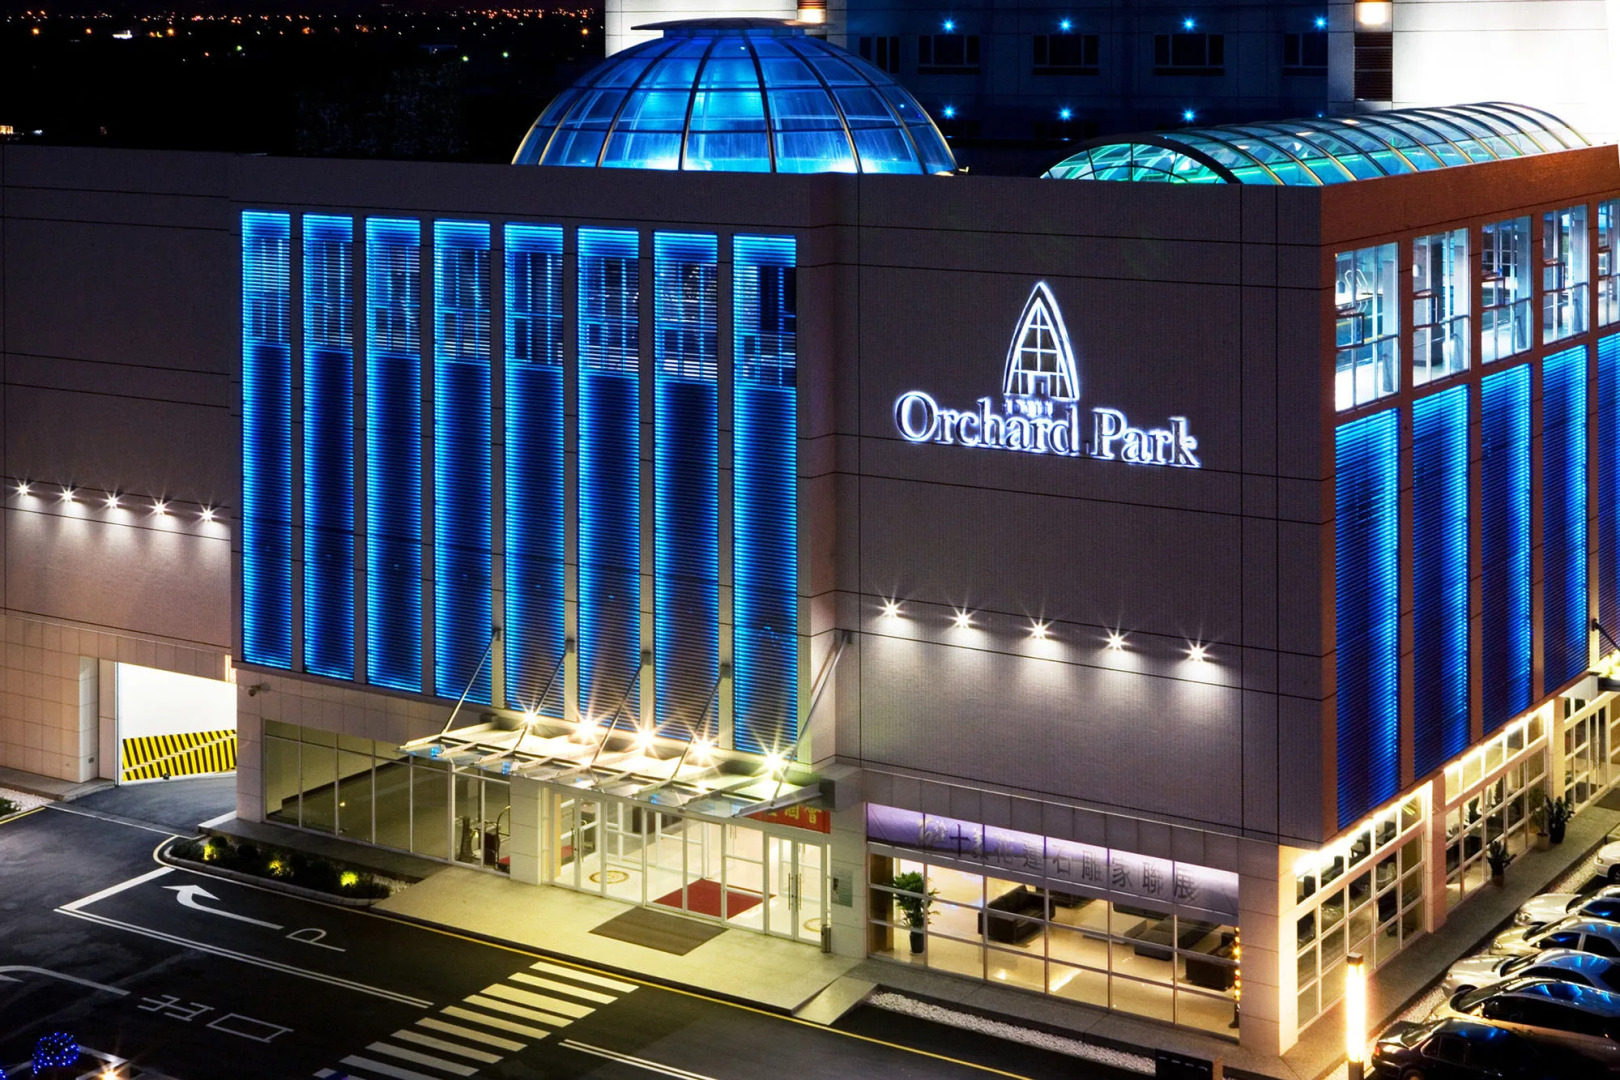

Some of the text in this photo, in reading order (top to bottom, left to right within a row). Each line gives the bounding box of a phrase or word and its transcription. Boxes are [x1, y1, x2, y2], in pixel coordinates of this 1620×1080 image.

[894, 390, 1201, 469] Orchard Park
[136, 994, 294, 1043] 出口
